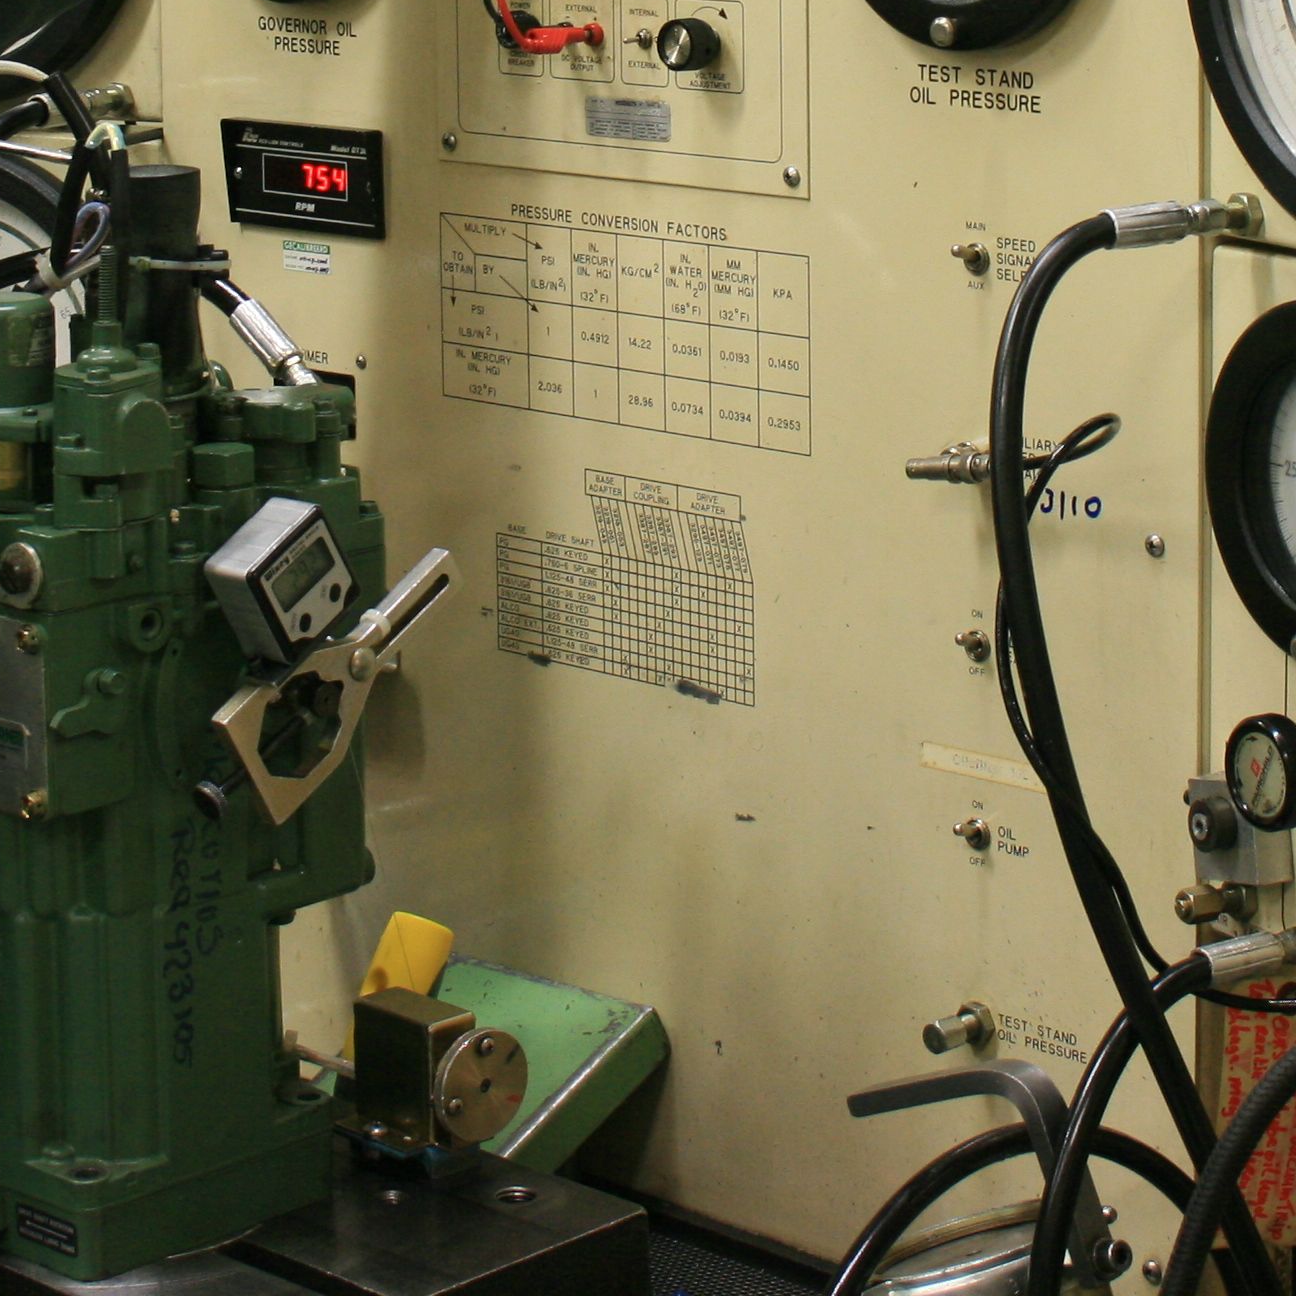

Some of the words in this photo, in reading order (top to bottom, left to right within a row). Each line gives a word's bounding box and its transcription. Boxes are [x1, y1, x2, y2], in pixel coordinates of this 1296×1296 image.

[565, 3, 598, 15] EXTERNAL
[629, 8, 658, 18] INTERNAL
[258, 15, 327, 36] GOVERNOR
[336, 21, 358, 38] OIL
[274, 36, 341, 56] PRESSURE
[570, 62, 594, 72] OUTPUT
[572, 55, 602, 65] VOLTAGE
[627, 60, 661, 71] EXTERNAL
[917, 63, 962, 84] TEST
[975, 68, 1034, 90] STAND
[689, 80, 732, 91] ADJUSTMENT
[909, 86, 937, 105] OIL
[950, 89, 1042, 114] PRESSURE
[301, 163, 346, 192] 754
[294, 202, 315, 213] RPM
[464, 222, 507, 236] MULTIPLY
[511, 203, 572, 224] PRESSURE
[581, 211, 659, 233] CONVERSION
[667, 222, 727, 241] FACTORS
[965, 221, 986, 232] MAIN
[996, 237, 1036, 253] SPEED
[453, 251, 464, 261] TO
[541, 255, 555, 266] PSI
[573, 253, 615, 267] MERCURY
[443, 262, 473, 275] OBTAIN
[482, 264, 494, 275] BY
[669, 265, 702, 278] WATER
[726, 259, 741, 271] MM
[711, 270, 756, 285] MERCURY
[967, 280, 985, 291] AUX
[580, 331, 610, 345] 0.4912
[627, 337, 652, 350] 14.22
[305, 349, 329, 365] IMER
[472, 351, 512, 365] MERCURY
[719, 350, 750, 364] 0.0193
[767, 357, 800, 371] 0.1450
[537, 381, 563, 394] 2.036
[627, 394, 654, 408] 28.96
[671, 401, 704, 415] 0.0734
[719, 409, 752, 423] 0.0394
[767, 417, 801, 431] 0.2953
[971, 609, 983, 620] ON
[968, 666, 985, 677] OFF
[971, 800, 984, 811] ON
[997, 826, 1017, 841] OIL
[997, 841, 1030, 858] PUMP
[969, 856, 987, 867] OFF
[998, 1013, 1027, 1032] TEST
[1037, 1024, 1077, 1046] STAND
[997, 1029, 1017, 1045] OIL
[1024, 1036, 1088, 1064] PRESSURE
